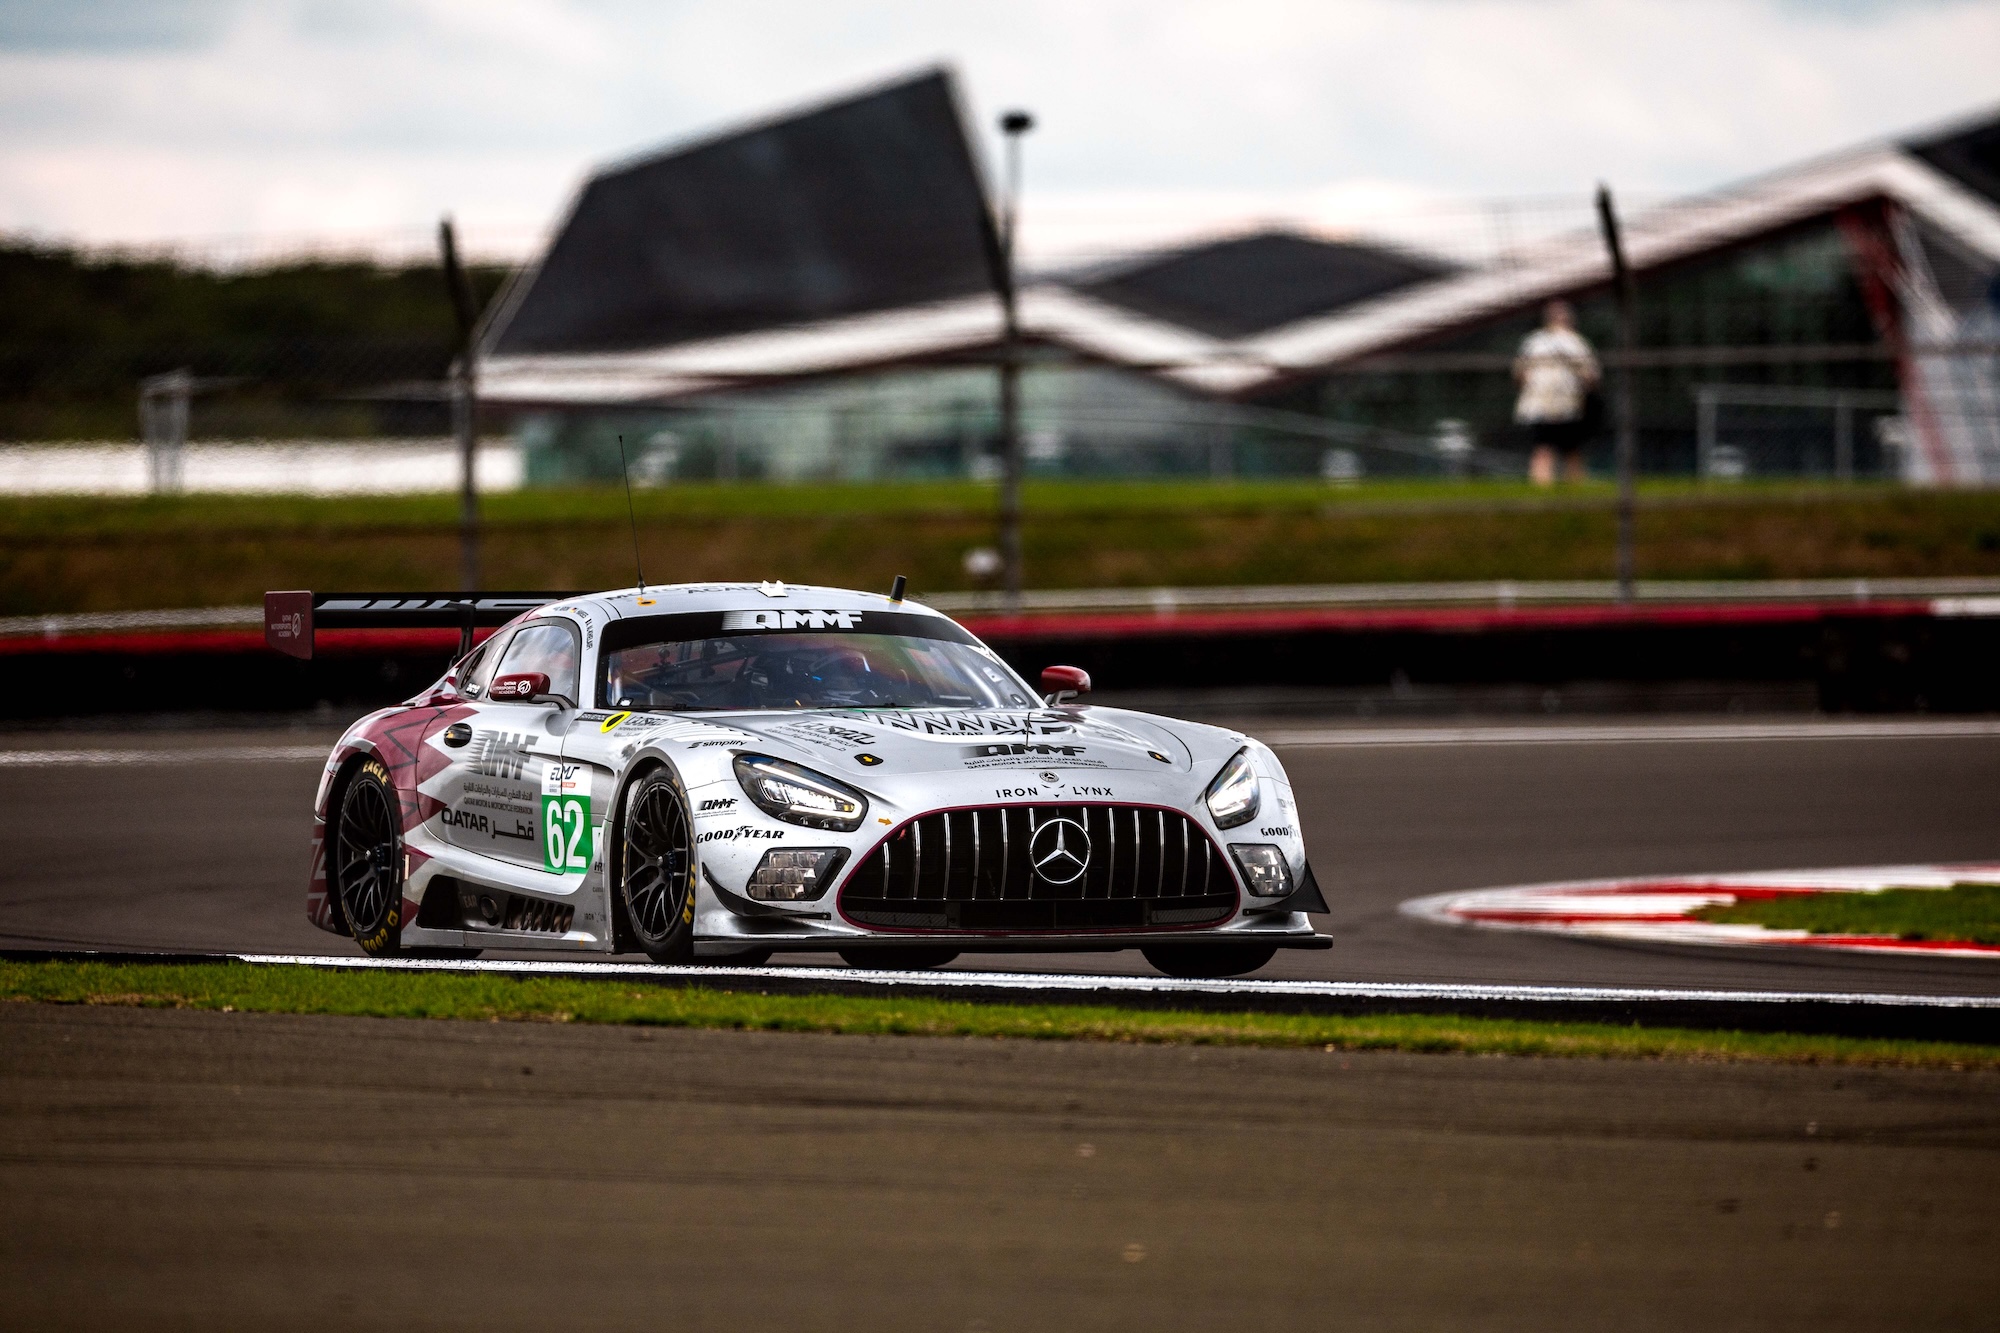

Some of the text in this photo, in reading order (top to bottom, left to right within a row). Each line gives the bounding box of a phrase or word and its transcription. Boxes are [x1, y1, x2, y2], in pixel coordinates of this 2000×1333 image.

[721, 610, 863, 630] QMMF
[362, 760, 389, 786] EAGLE
[996, 786, 1114, 798] IRON LYNX
[441, 808, 489, 833] QATAR
[491, 819, 535, 841] قطر
[546, 800, 587, 869] 62
